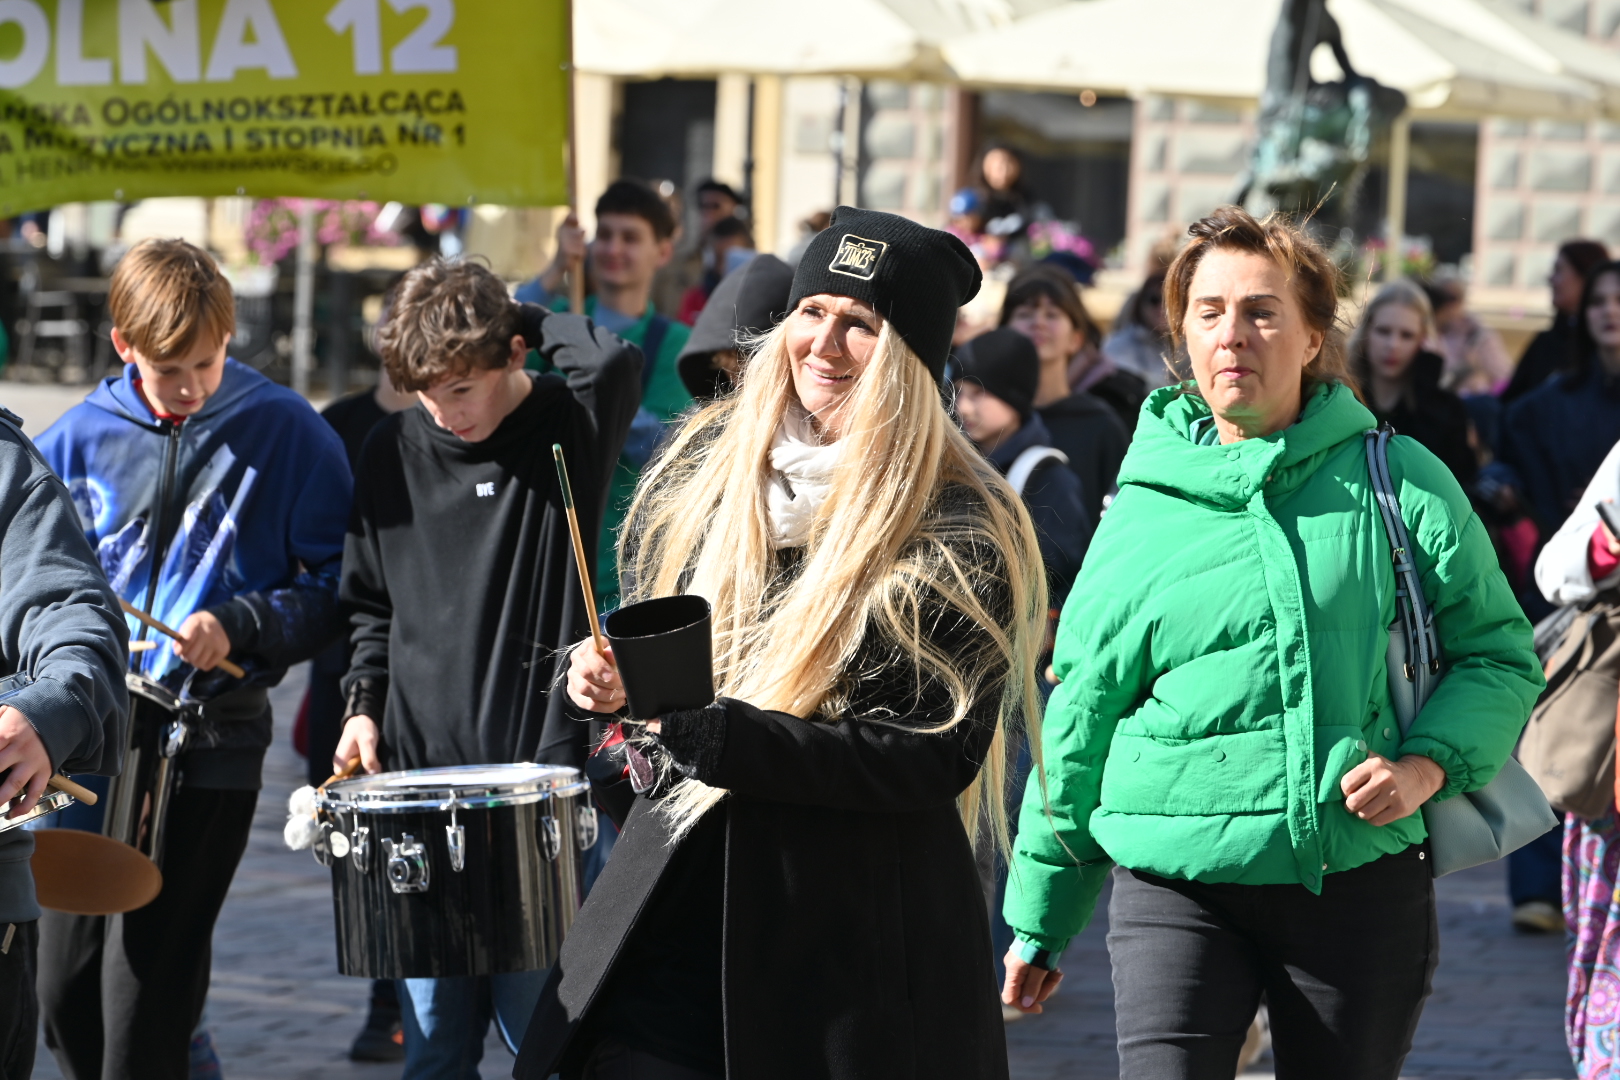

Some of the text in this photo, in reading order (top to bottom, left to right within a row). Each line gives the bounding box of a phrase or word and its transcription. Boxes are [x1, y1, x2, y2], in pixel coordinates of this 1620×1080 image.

[0, 0, 459, 90] OLNA 12
[102, 88, 466, 127] OGÓLNOKSZTAŁCĄCA
[224, 126, 234, 151] I
[245, 125, 387, 151] STOPNIA
[397, 122, 443, 147] NR
[452, 122, 467, 147] 1
